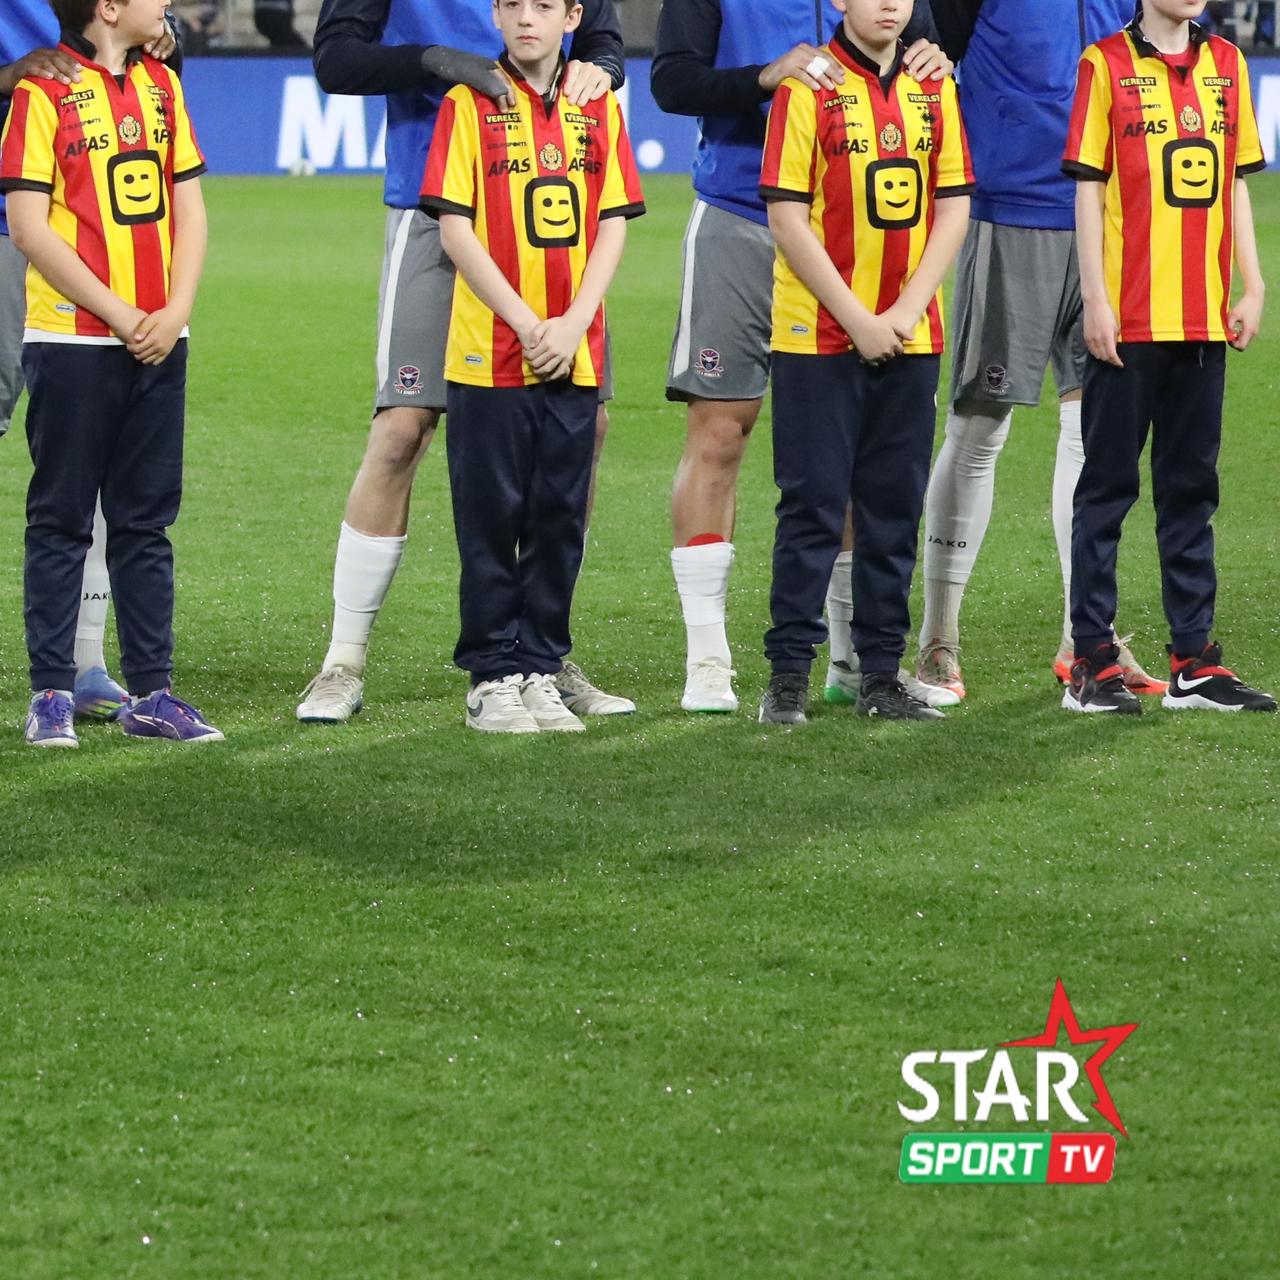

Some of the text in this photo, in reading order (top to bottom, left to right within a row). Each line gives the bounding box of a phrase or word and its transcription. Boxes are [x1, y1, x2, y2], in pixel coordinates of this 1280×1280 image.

[1120, 77, 1155, 87] VERELST
[1122, 120, 1168, 138] AFAS
[65, 134, 109, 158] AFAS
[488, 158, 530, 177] AFAS
[928, 534, 967, 549] JAKO
